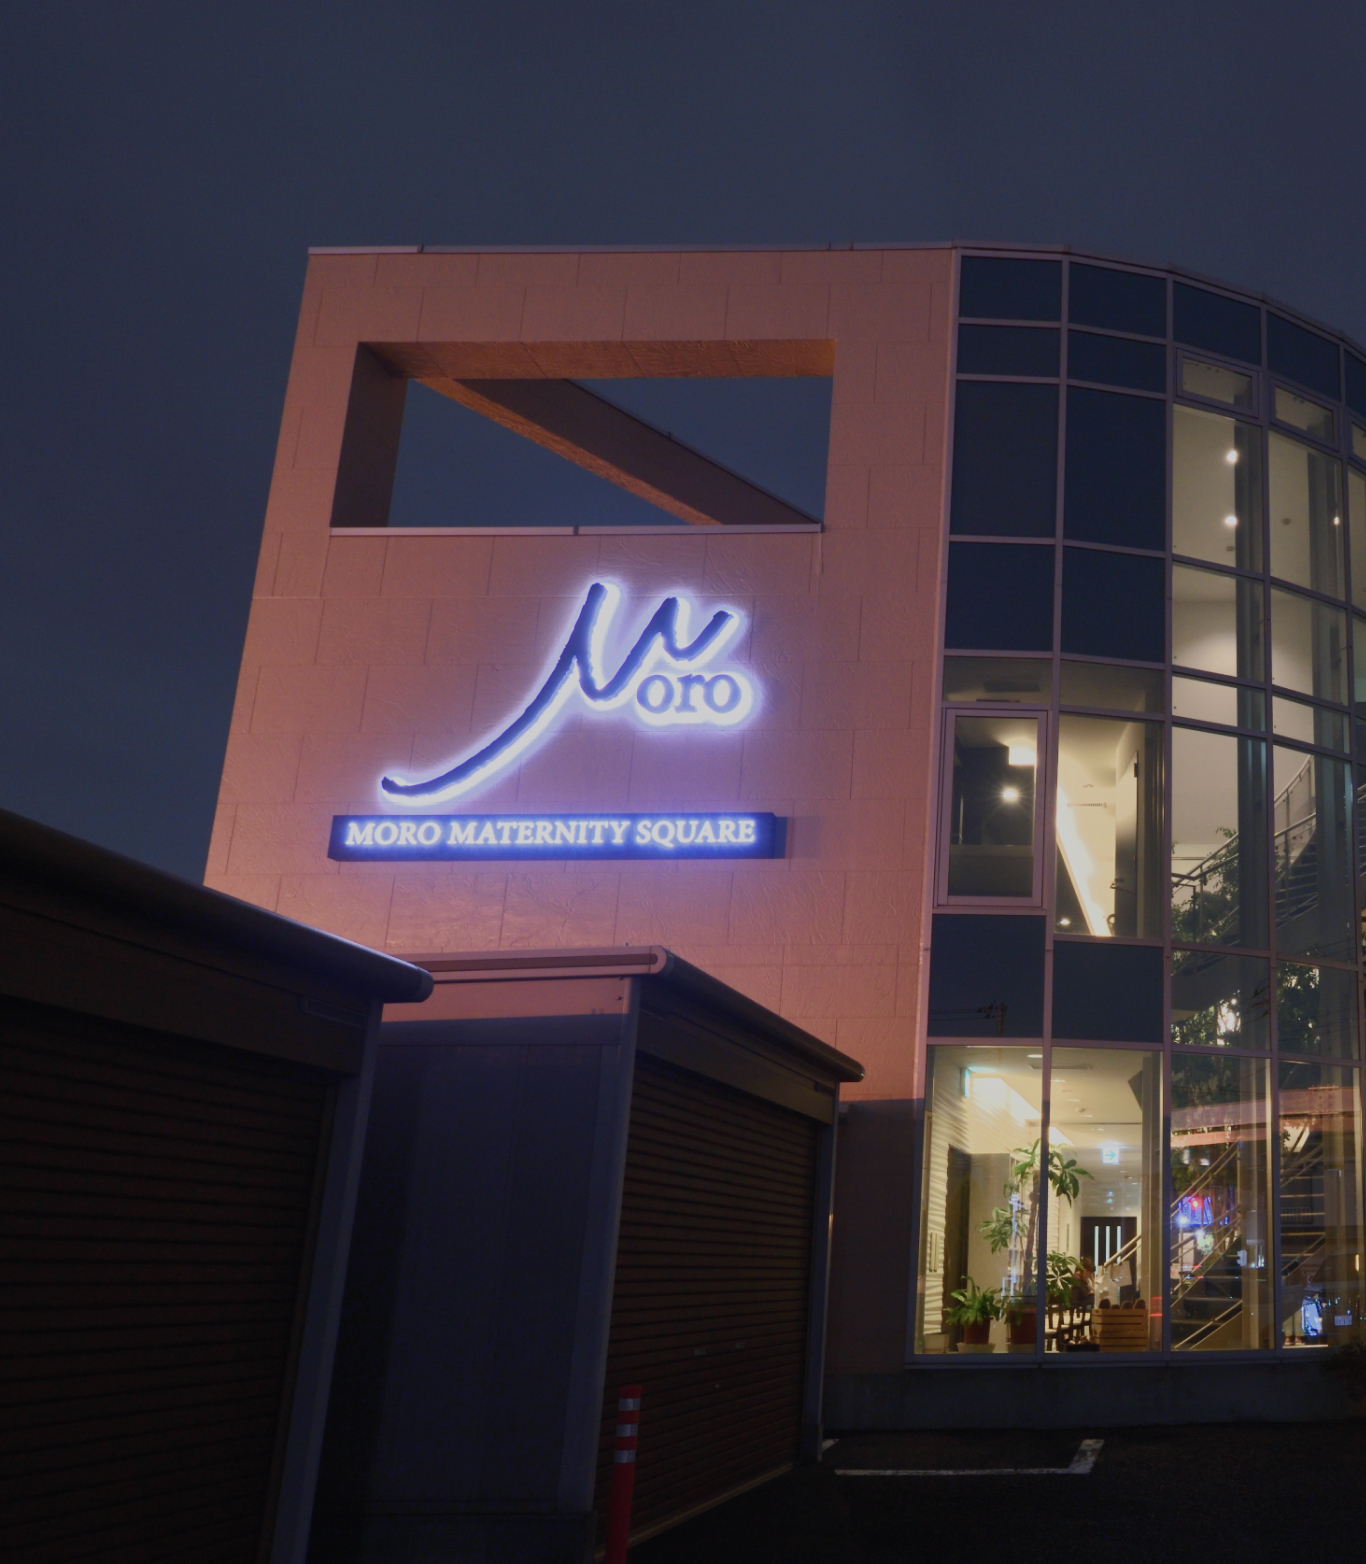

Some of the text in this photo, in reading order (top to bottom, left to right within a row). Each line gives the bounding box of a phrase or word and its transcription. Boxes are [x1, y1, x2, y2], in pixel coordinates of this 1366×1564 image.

[345, 820, 756, 848] MORO MATERNITY SQUARE
